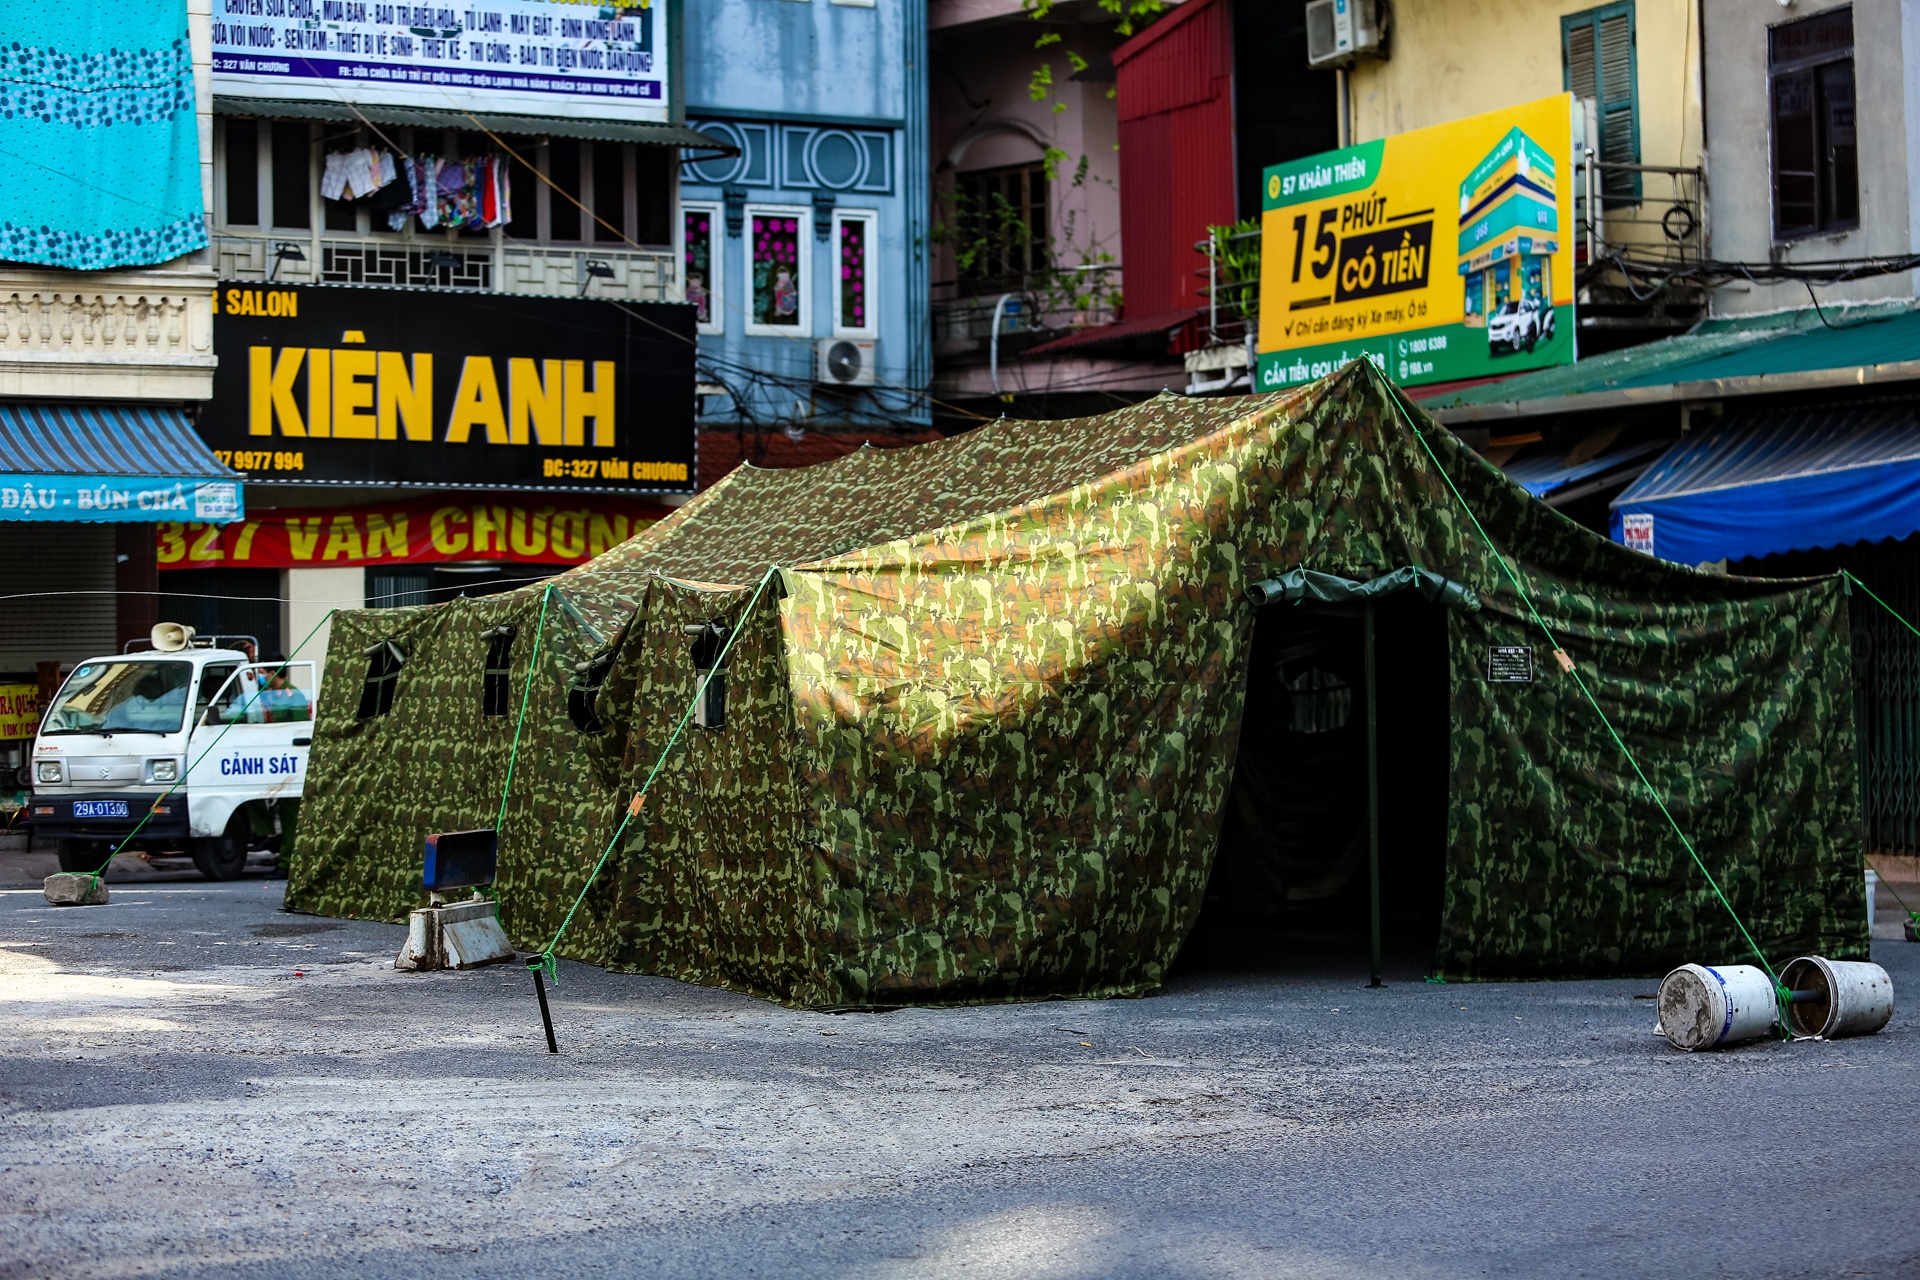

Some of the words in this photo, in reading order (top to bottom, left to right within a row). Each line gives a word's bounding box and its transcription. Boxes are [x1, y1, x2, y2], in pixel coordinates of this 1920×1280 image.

[323, 1, 344, 22] MUA
[347, 0, 367, 23] BÁN
[230, 20, 246, 46] VÒI
[249, 23, 275, 48] NƯỚC
[285, 28, 304, 50] SEN
[222, 59, 238, 70] 327
[1282, 175, 1296, 196] 57
[1298, 165, 1332, 192] KHÂM
[1334, 156, 1367, 183] THIÊN
[1342, 190, 1387, 232] PHÚT
[1291, 207, 1338, 284] 15
[1341, 245, 1377, 292] CÓ
[1382, 229, 1425, 286] TIỀN
[226, 288, 297, 318] SALON
[1370, 310, 1381, 324] Xe
[1264, 361, 1287, 386] CẦN
[1288, 357, 1309, 382] TIỀN
[248, 330, 433, 441] KIÊN
[445, 356, 615, 448] ANH
[234, 450, 272, 470] 9977
[274, 451, 304, 471] 994
[601, 457, 628, 479] VĂN
[632, 462, 688, 481] CHƯƠNG
[1, 482, 57, 515] ĐẬU
[77, 483, 130, 510] BÚN
[137, 482, 188, 511] CHẢ
[157, 517, 262, 563] 327
[430, 504, 659, 559] CHƯƠN
[221, 752, 264, 775] CẢNH
[269, 753, 298, 774] SÁT
